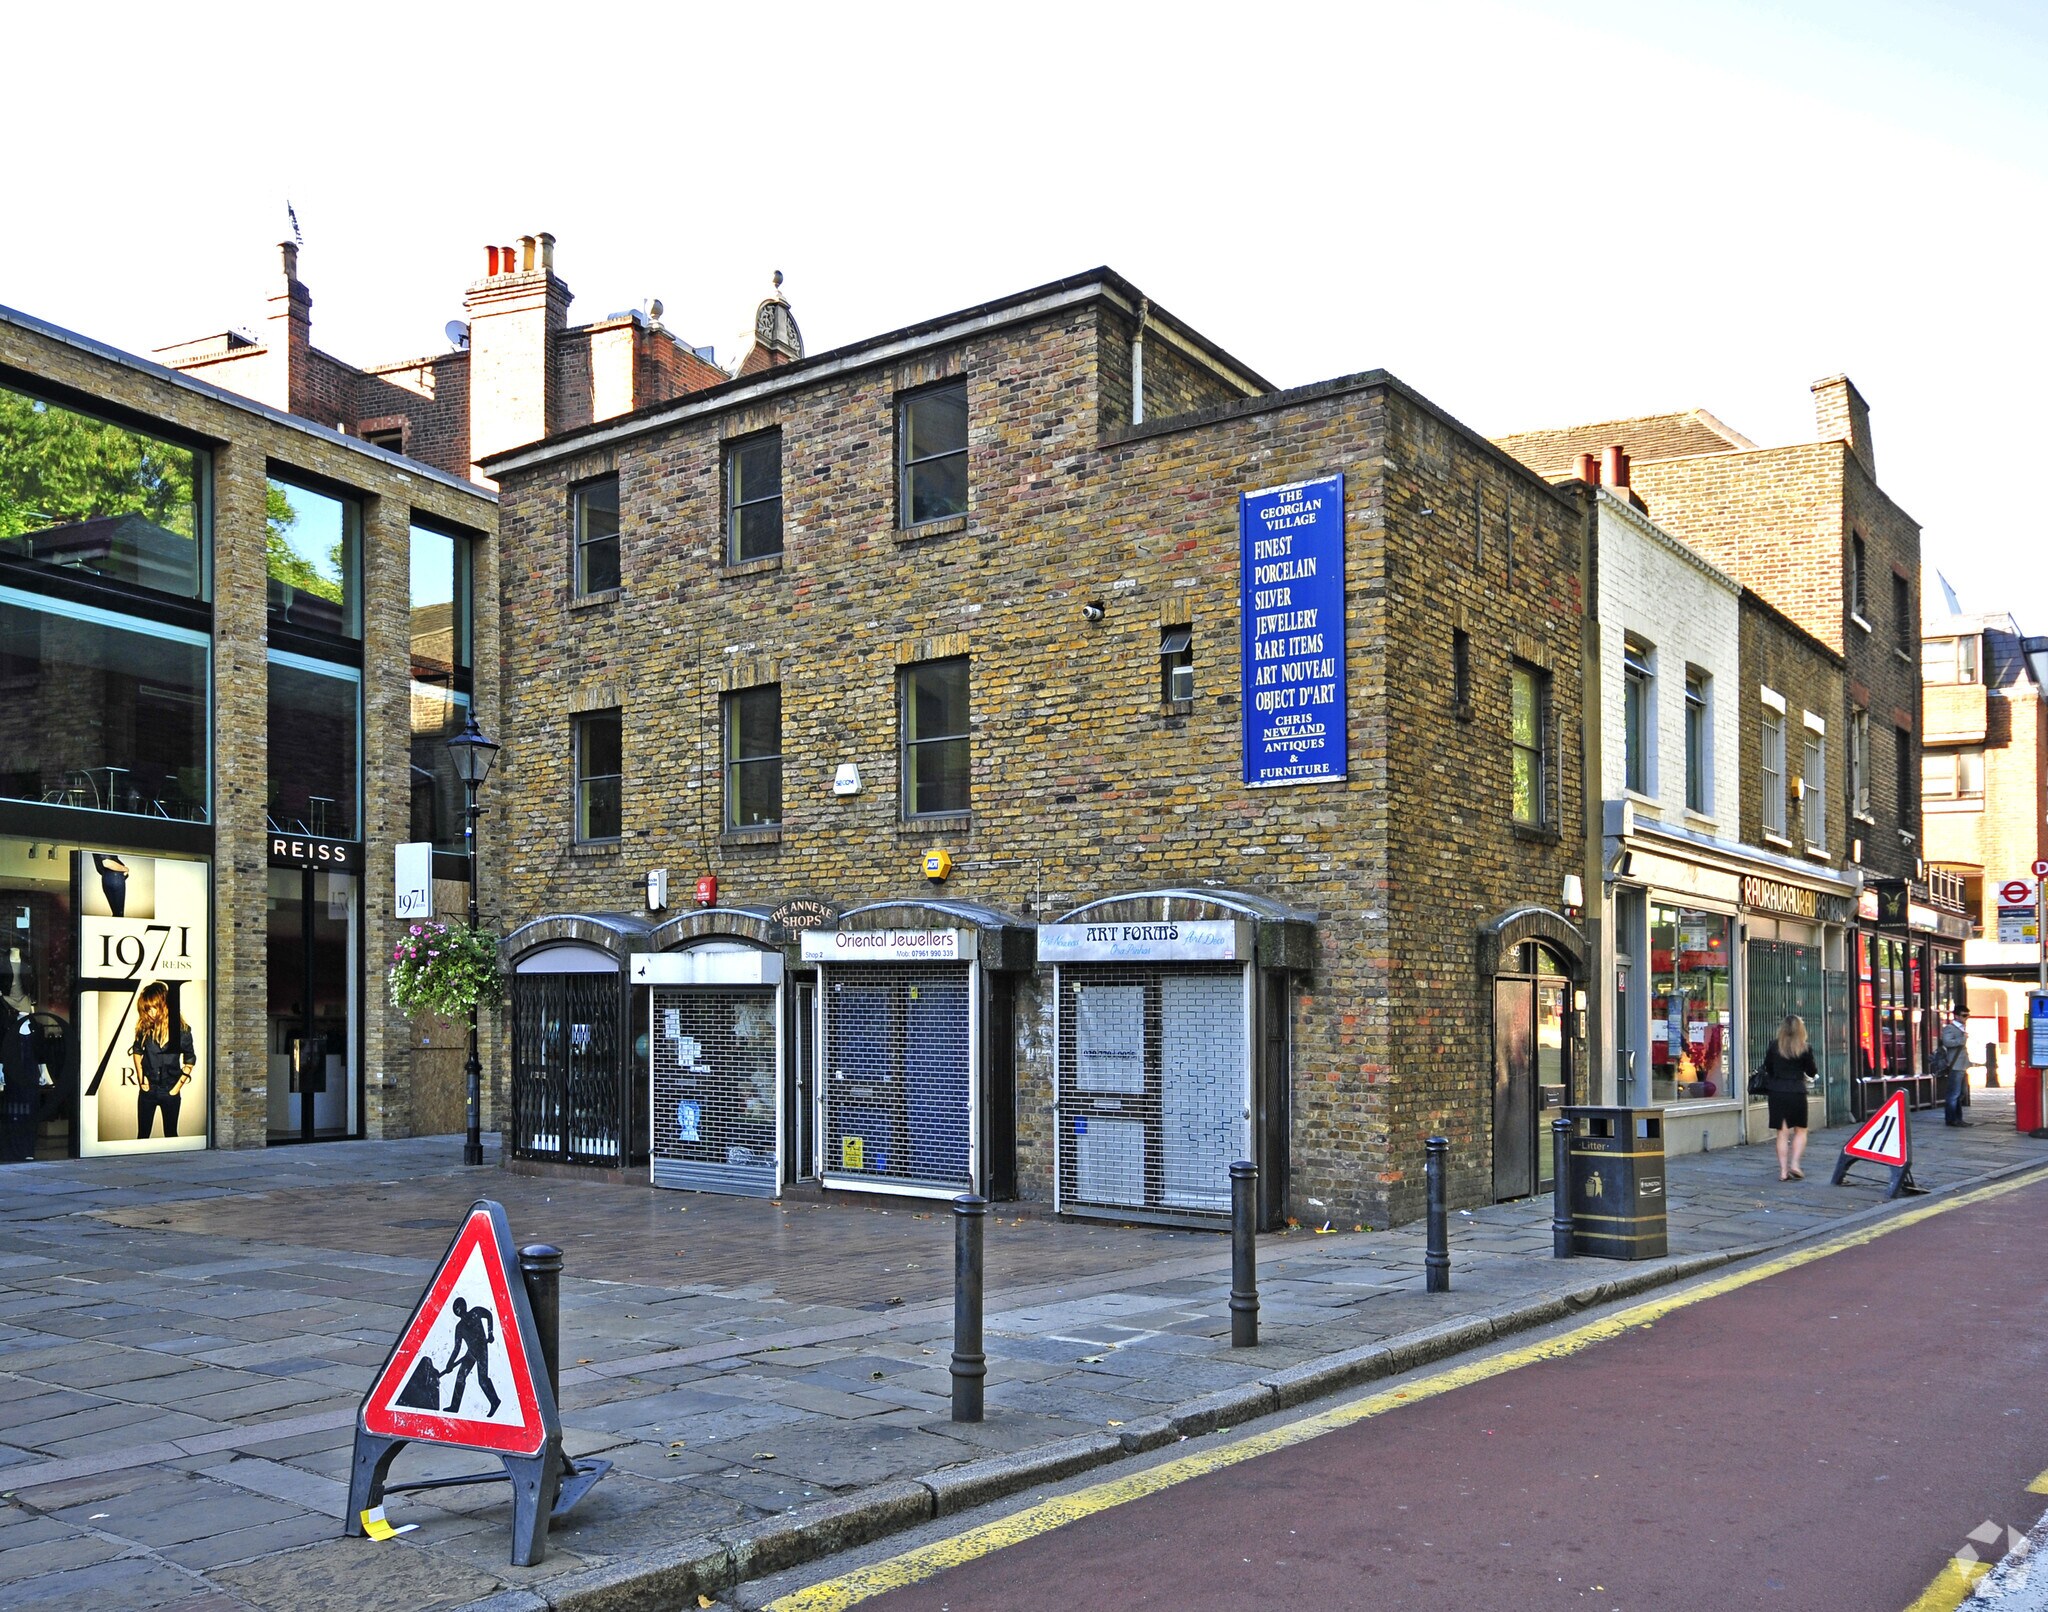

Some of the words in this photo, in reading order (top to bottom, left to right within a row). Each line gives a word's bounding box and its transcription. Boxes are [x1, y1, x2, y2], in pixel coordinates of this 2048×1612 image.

[1278, 490, 1303, 503] THE
[1260, 499, 1322, 519] GEORGIAN
[1266, 513, 1317, 531] VILLAGE
[1254, 535, 1293, 560] FINEST
[1254, 557, 1317, 585] PORCELAIN
[1255, 587, 1292, 610] SILVER
[1255, 608, 1318, 641] JEWELLERY
[1255, 638, 1286, 661] RARE
[1289, 633, 1324, 656] ITEMS
[1255, 665, 1278, 686] ART
[1281, 658, 1335, 683] NOUVEAU
[1255, 688, 1296, 714] OBJECT
[1275, 713, 1312, 726] CHRIS
[1263, 723, 1325, 738] NEWLAND
[1264, 738, 1325, 753] ANTIQUES
[1289, 754, 1299, 763] &
[1260, 763, 1330, 778] FURNITURE
[273, 839, 346, 863] REISS
[2036, 861, 2048, 875] D
[398, 889, 425, 915] 1971
[771, 905, 789, 922] THE
[790, 900, 834, 920] ANNEXE
[782, 915, 822, 928] SHOPS
[836, 932, 887, 948] Oriental
[891, 932, 954, 947] Jewellers
[1086, 926, 1119, 942] ART
[1123, 925, 1179, 941] FORMS
[1183, 932, 1201, 946] Art
[1204, 934, 1225, 945] Deco
[99, 925, 192, 980] 1971
[162, 960, 192, 969] REISS
[1582, 1142, 1606, 1151] Litter
